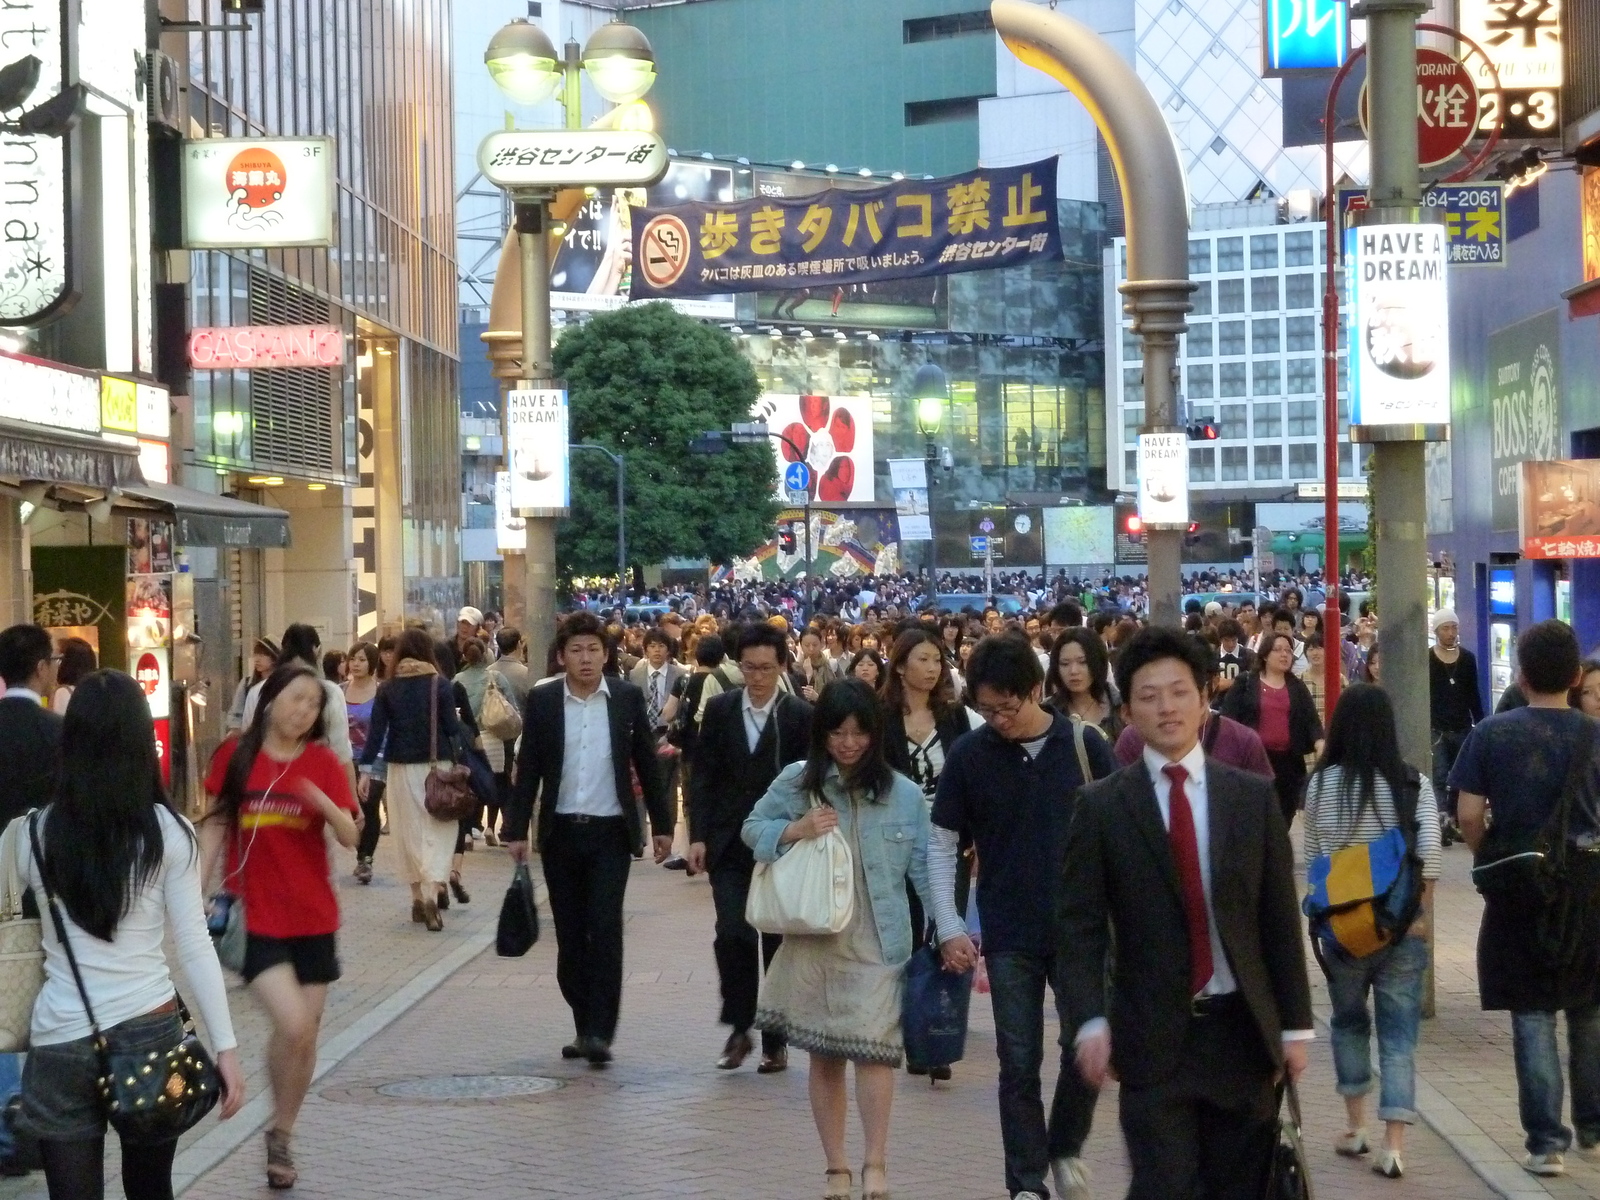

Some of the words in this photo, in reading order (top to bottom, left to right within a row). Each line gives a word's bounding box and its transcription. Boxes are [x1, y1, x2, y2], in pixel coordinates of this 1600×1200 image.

[1415, 63, 1457, 77] YDRANT
[302, 146, 322, 158] 3F
[490, 144, 656, 167] 渋谷センター街
[1419, 190, 1498, 207] 464-2061
[699, 172, 1049, 260] 歩きタバコ禁止
[938, 232, 1049, 263] 渋谷センター街
[1362, 233, 1423, 256] HAVE
[1433, 233, 1440, 255] A
[700, 249, 926, 283] タバコは灰皿のある喫煙場所で吸いましょう。
[1363, 259, 1441, 282] DREAM!
[512, 395, 545, 408] HAVE
[552, 395, 558, 407] A
[513, 411, 559, 423] DREAM!
[1492, 389, 1528, 459] BOSS
[1144, 437, 1171, 447] HAVE
[1498, 465, 1518, 496] COFF
[1541, 540, 1600, 556] 七輪焼
[36, 602, 92, 625] 肴菜や
